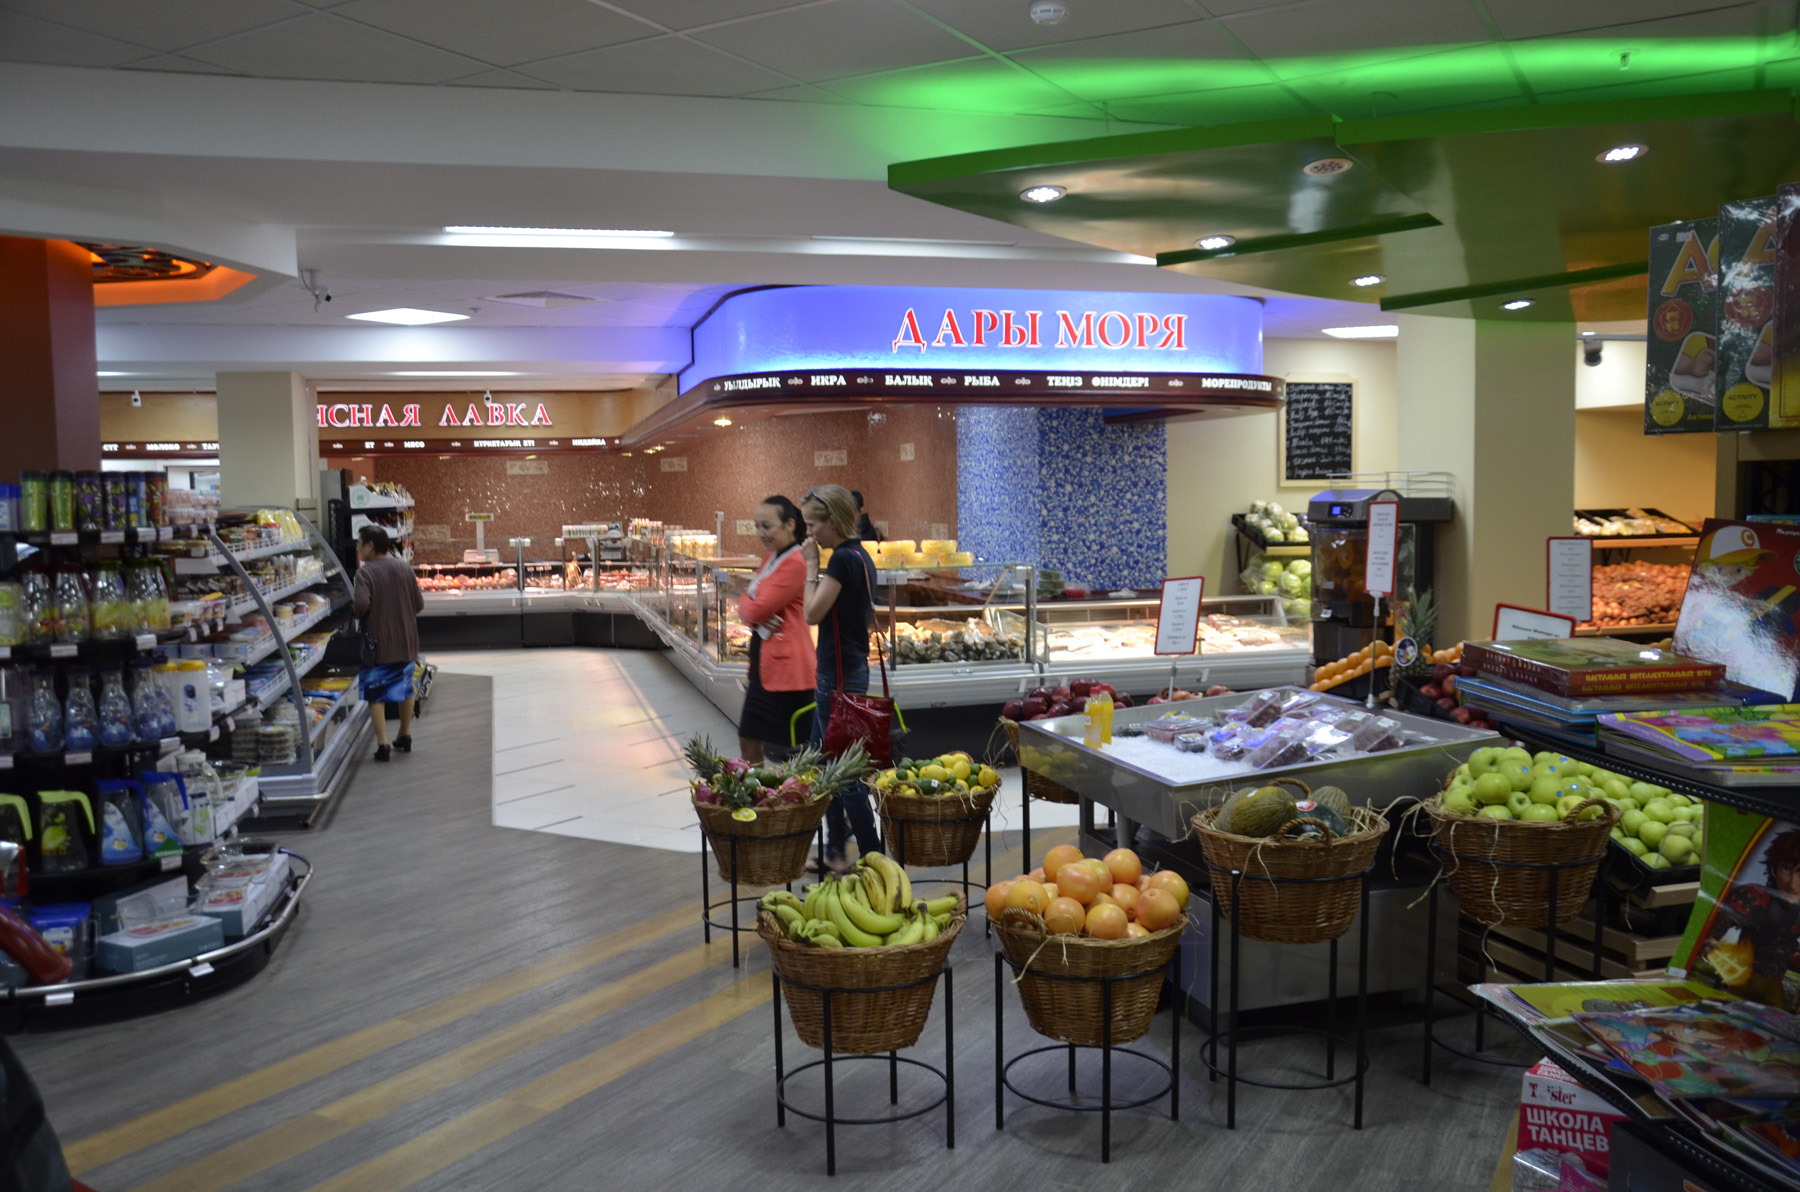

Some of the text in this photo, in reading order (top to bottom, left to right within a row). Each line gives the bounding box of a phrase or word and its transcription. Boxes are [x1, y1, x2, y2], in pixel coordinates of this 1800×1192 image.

[892, 307, 1188, 354] ДАРЫ МОРЯ
[723, 376, 782, 391] УЫЛДЫРЫҚ
[810, 374, 847, 386] ИКРА
[885, 374, 934, 387] БАЛЫҚ
[964, 375, 1001, 387] РЫБА
[1047, 376, 1083, 387] ТЕҢІЗ
[1202, 378, 1273, 392] МОРЕПРОДУКТЫ
[1727, 393, 1758, 401] ACTIVITY
[439, 402, 553, 427] ЛАВКА
[146, 443, 181, 451] МОЛОКО
[404, 440, 426, 449] МЯСО
[572, 438, 607, 447] ИНДЕЙКА
[1529, 1081, 1577, 1105] Tster
[1526, 1107, 1604, 1133] ШКОЛА
[1528, 1124, 1610, 1152] ТАНЦЕВ
